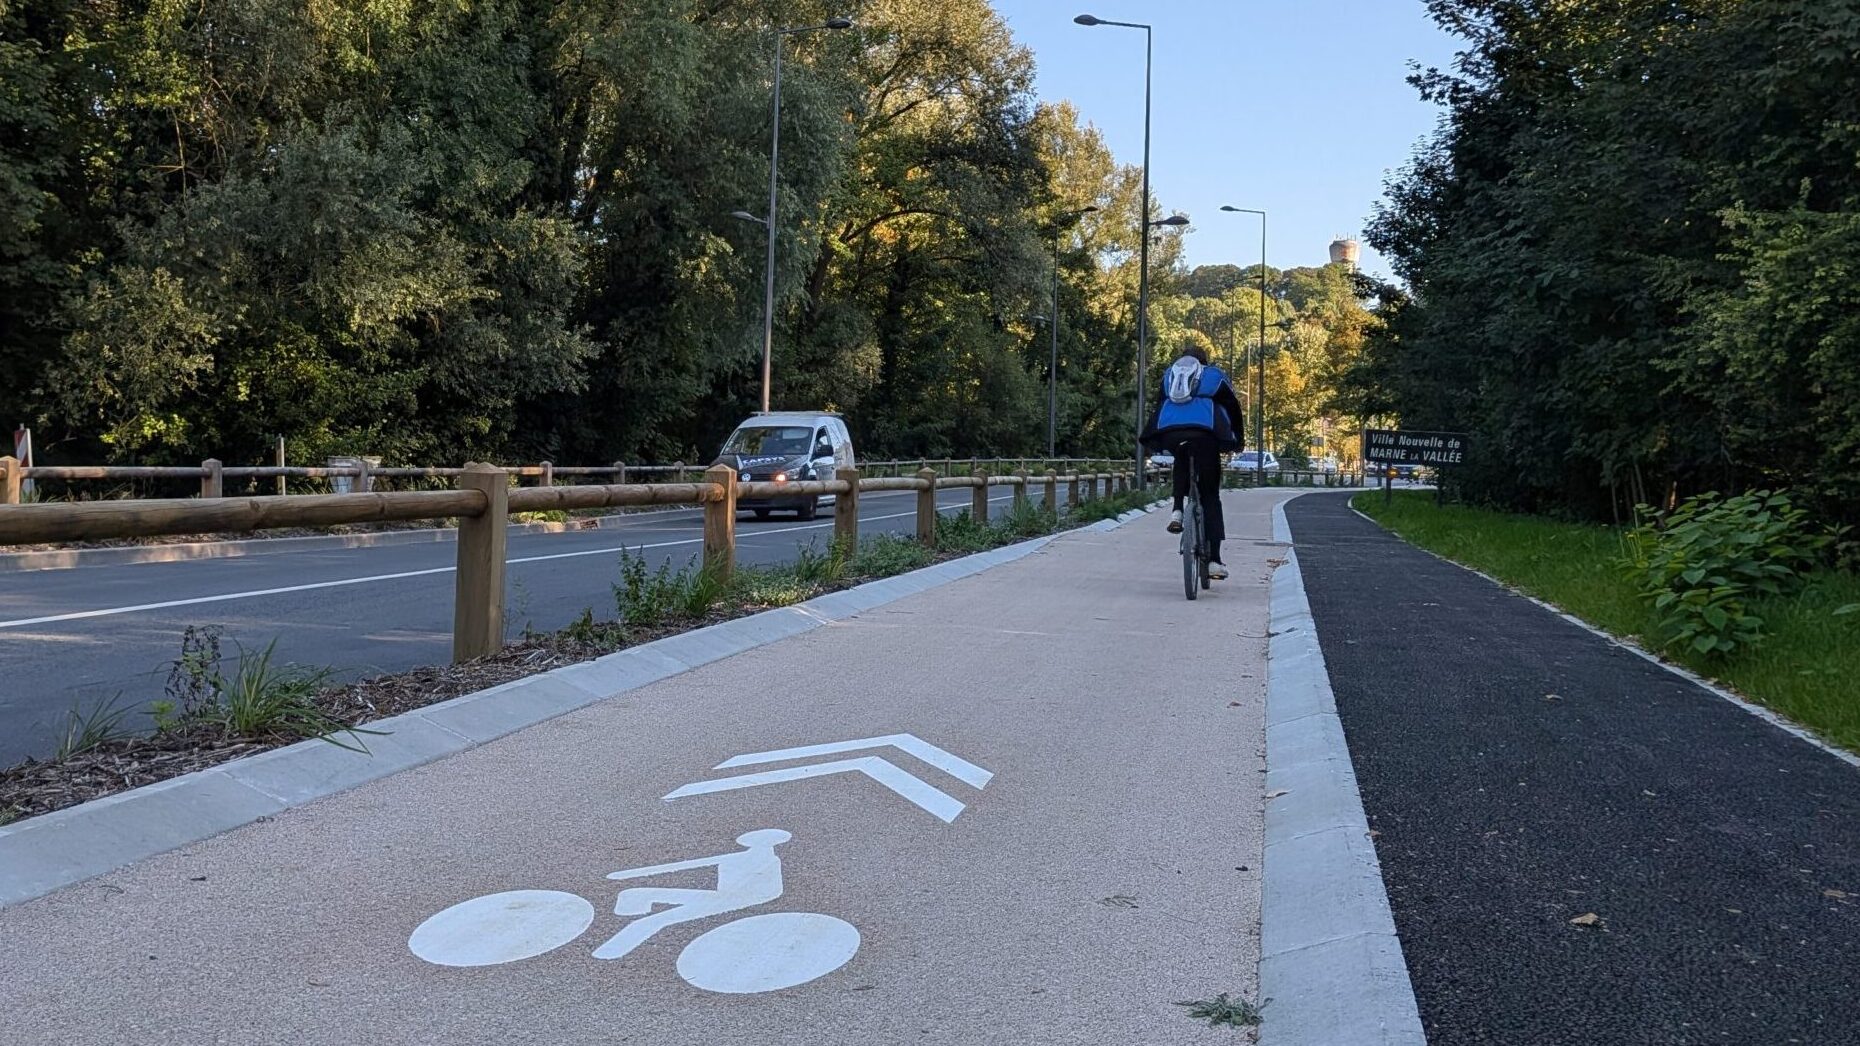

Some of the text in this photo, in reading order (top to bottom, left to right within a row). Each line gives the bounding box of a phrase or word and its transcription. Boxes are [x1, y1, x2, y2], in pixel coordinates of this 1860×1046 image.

[1372, 433, 1461, 449] Ville Nouvelle de
[1370, 447, 1407, 460] MARNE
[1423, 449, 1462, 463] VALLÉE
